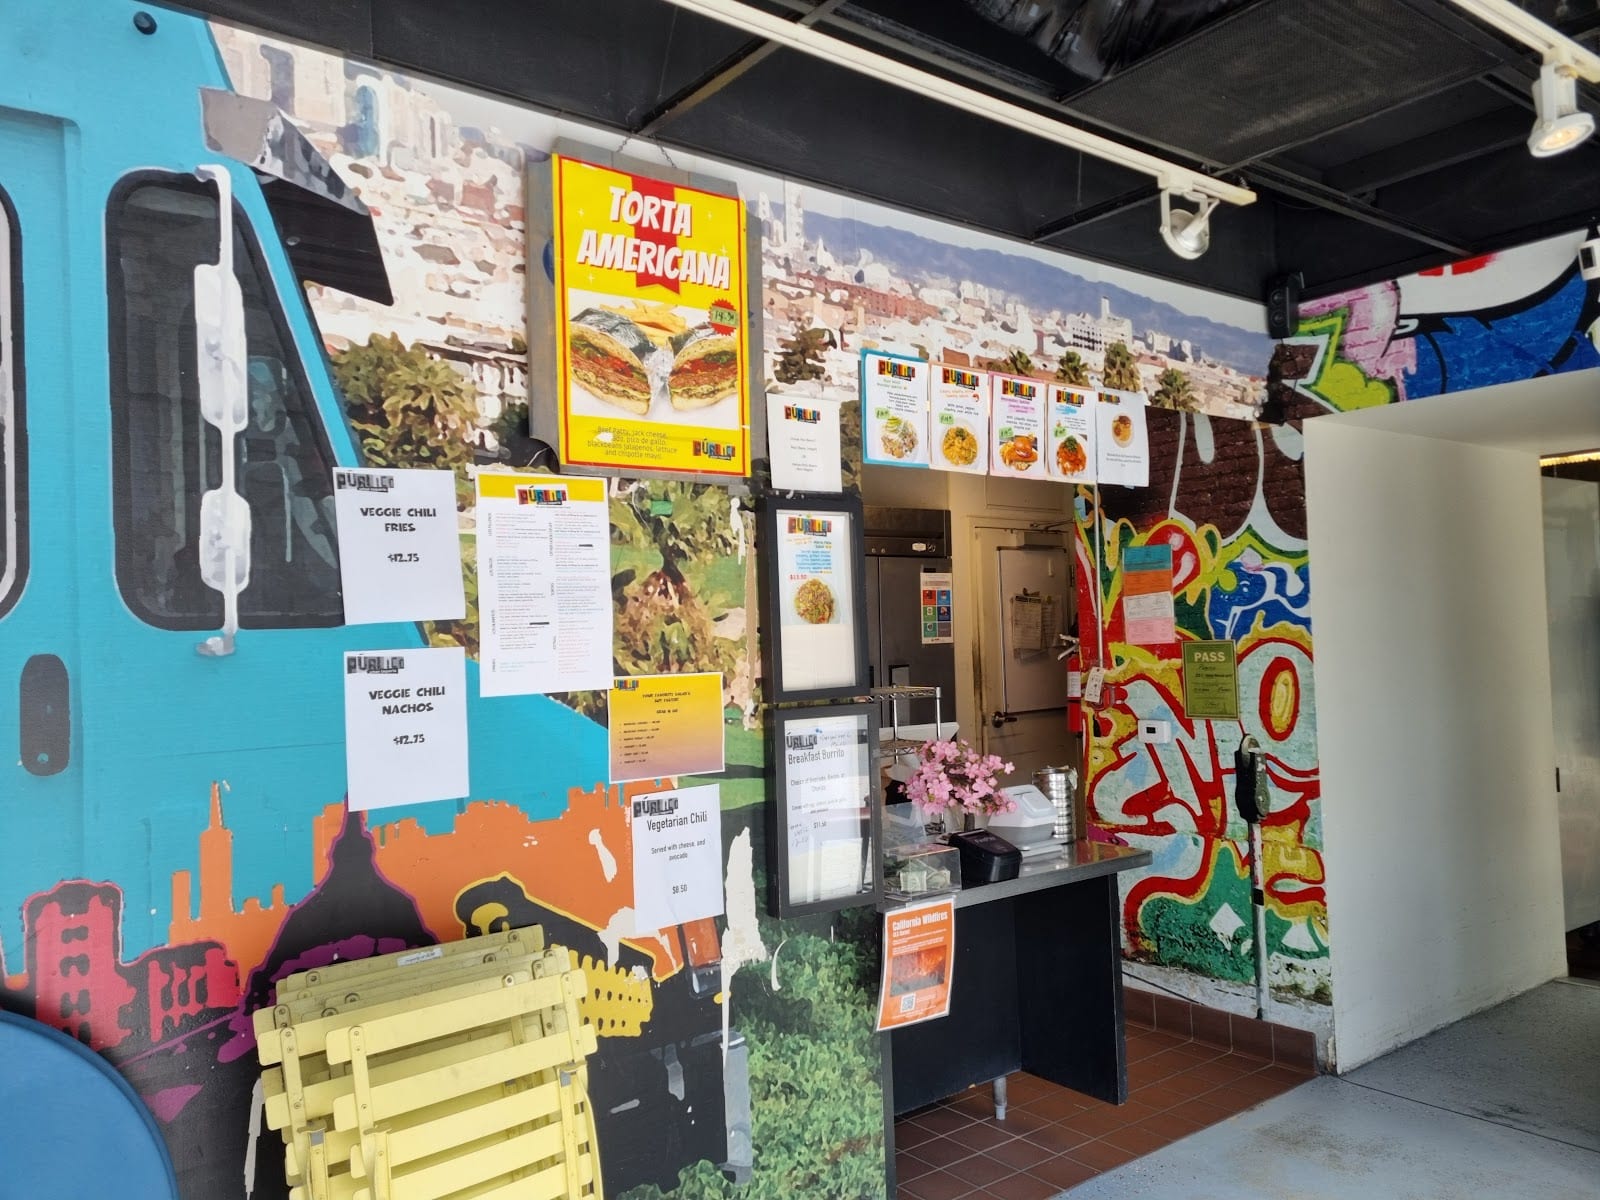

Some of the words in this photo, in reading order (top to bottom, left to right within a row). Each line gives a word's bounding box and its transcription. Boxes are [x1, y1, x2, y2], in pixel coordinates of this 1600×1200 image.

[609, 186, 692, 237] TORTA
[576, 229, 730, 290] AMERICANA
[360, 507, 401, 517] VEGGIE
[407, 508, 437, 517] CHILI
[384, 523, 416, 532] FRIES
[387, 553, 420, 563] $12.75
[1194, 651, 1226, 662] PASS
[369, 688, 410, 700] VEGGIE
[416, 686, 445, 697] CHILI
[382, 702, 434, 715] NACHOS
[393, 734, 425, 745] $12.75
[788, 751, 821, 765] Breakfast
[822, 749, 845, 760] Burrito
[646, 815, 689, 832] Vegetarian
[690, 811, 708, 823] Chili
[651, 845, 667, 854] Served
[669, 852, 688, 861] avocado
[672, 884, 688, 894] $8.50
[893, 916, 921, 931] California
[922, 911, 948, 925] Wildfires
